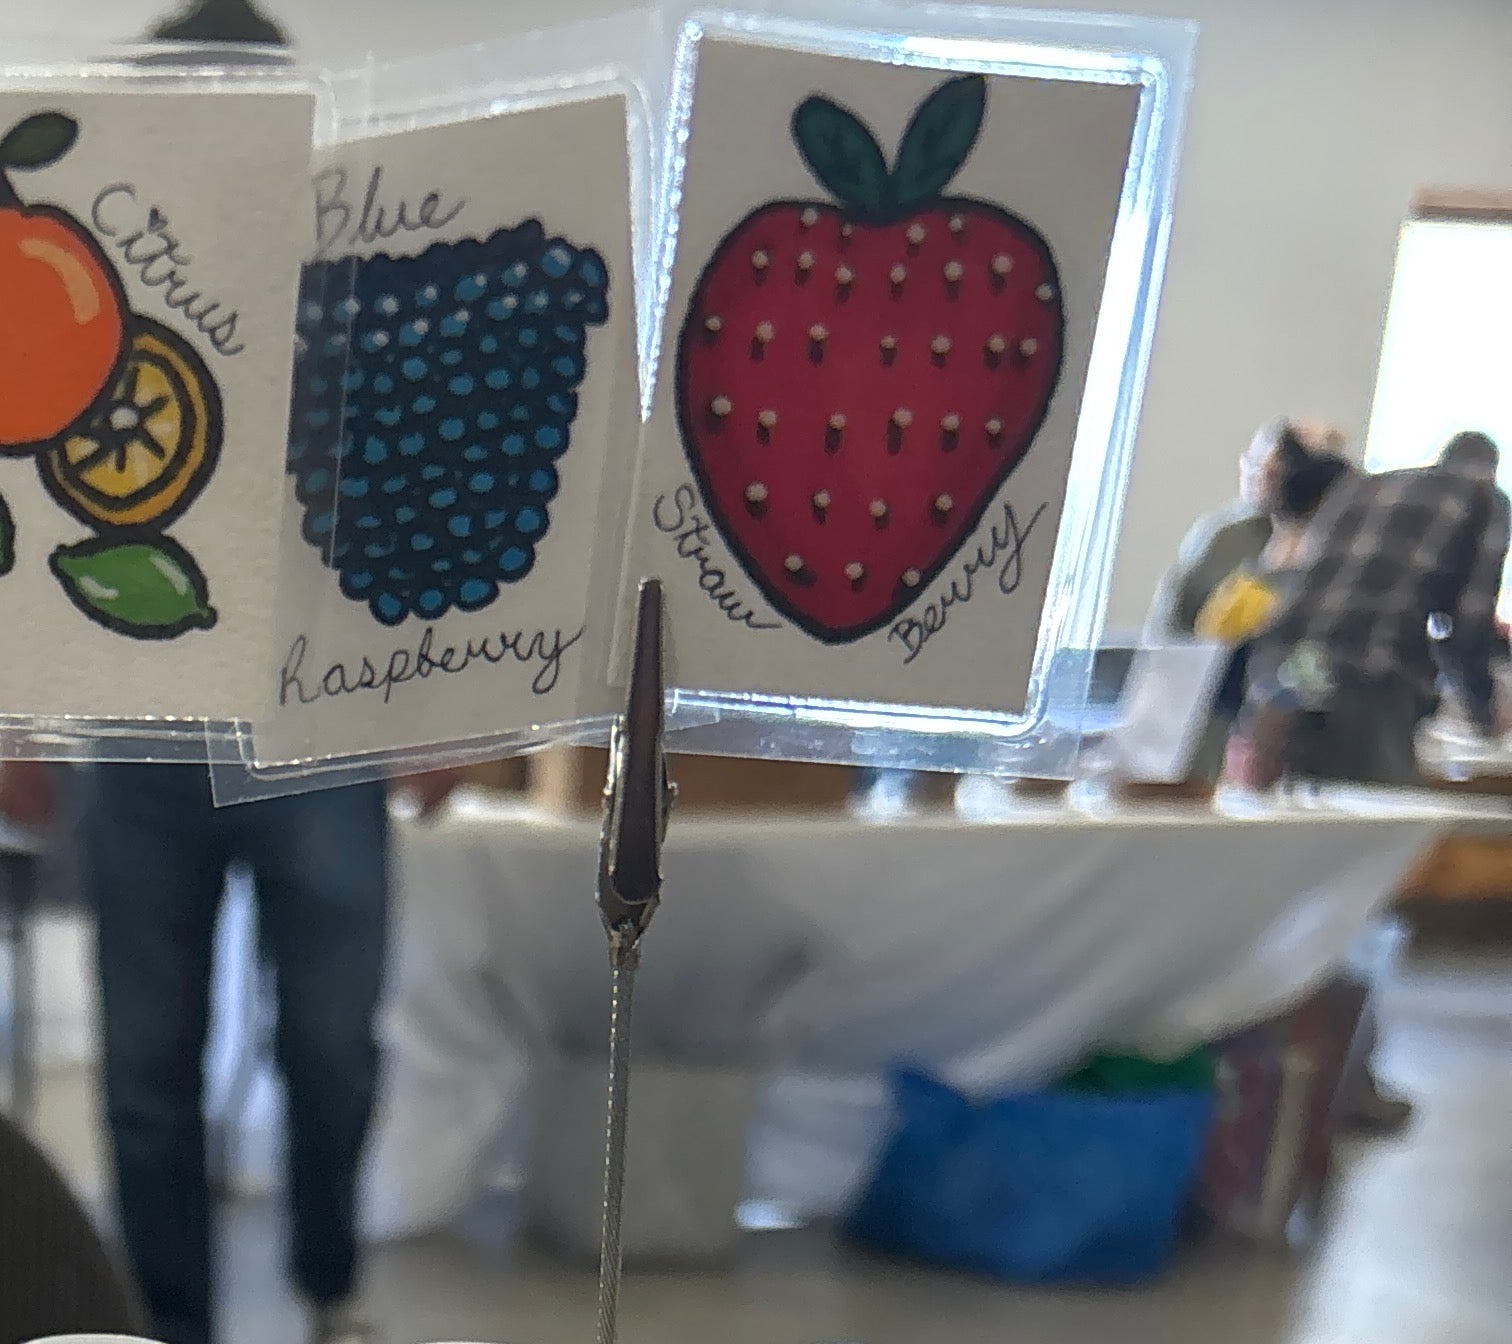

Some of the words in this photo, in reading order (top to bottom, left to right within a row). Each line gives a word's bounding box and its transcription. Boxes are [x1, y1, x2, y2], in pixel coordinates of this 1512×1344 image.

[91, 182, 245, 359] Citrus
[310, 166, 468, 255] Blue
[652, 481, 783, 633] Straw
[888, 498, 1048, 666] Berry
[277, 616, 585, 706] Raspberry
